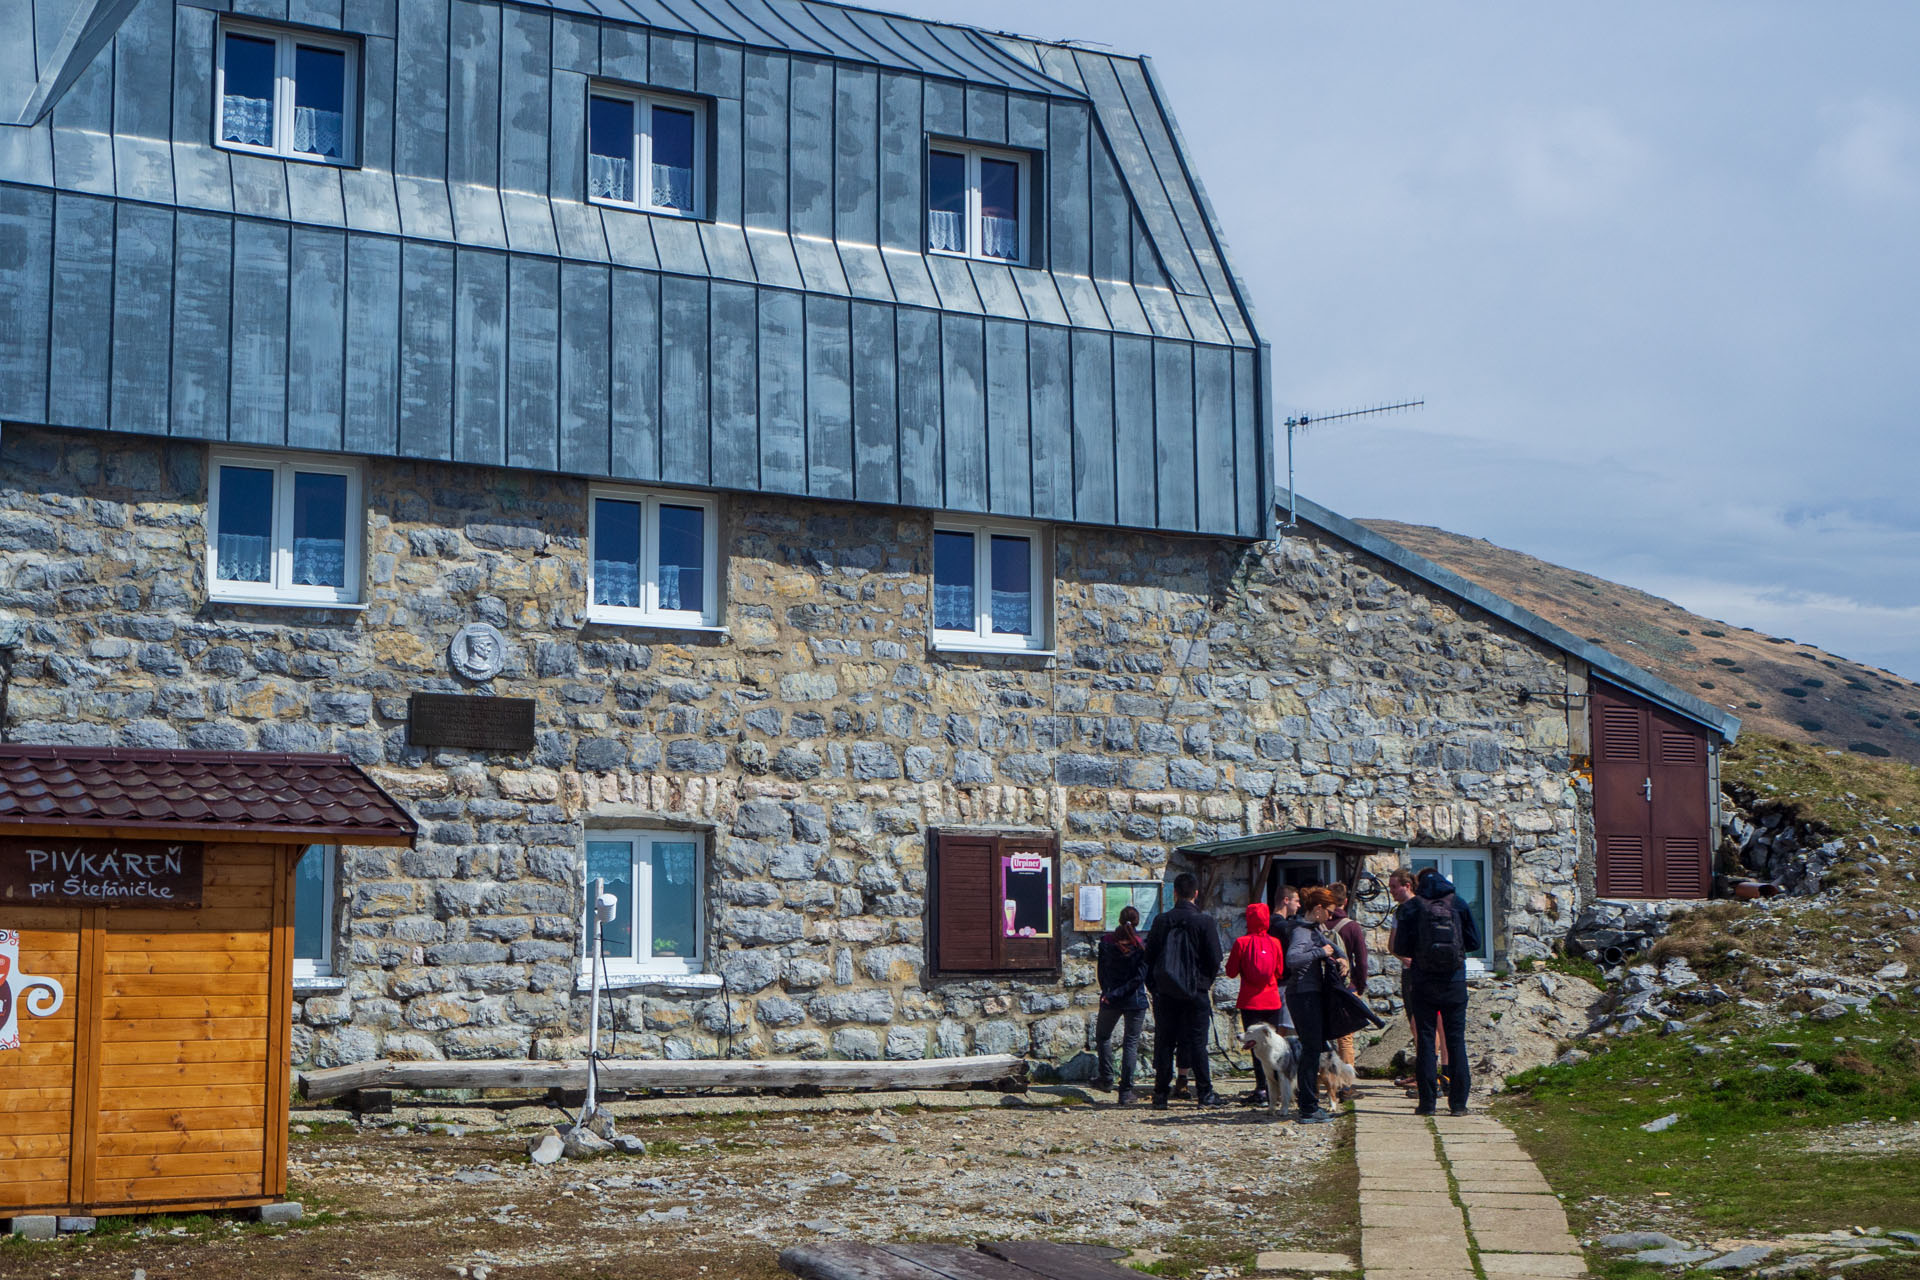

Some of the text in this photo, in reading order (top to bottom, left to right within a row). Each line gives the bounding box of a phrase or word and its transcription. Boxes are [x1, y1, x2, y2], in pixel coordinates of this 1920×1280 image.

[26, 846, 183, 879] PIVKÁREŇ
[1013, 858, 1040, 868] Urpiner
[29, 874, 174, 899] pri Štefáničke
